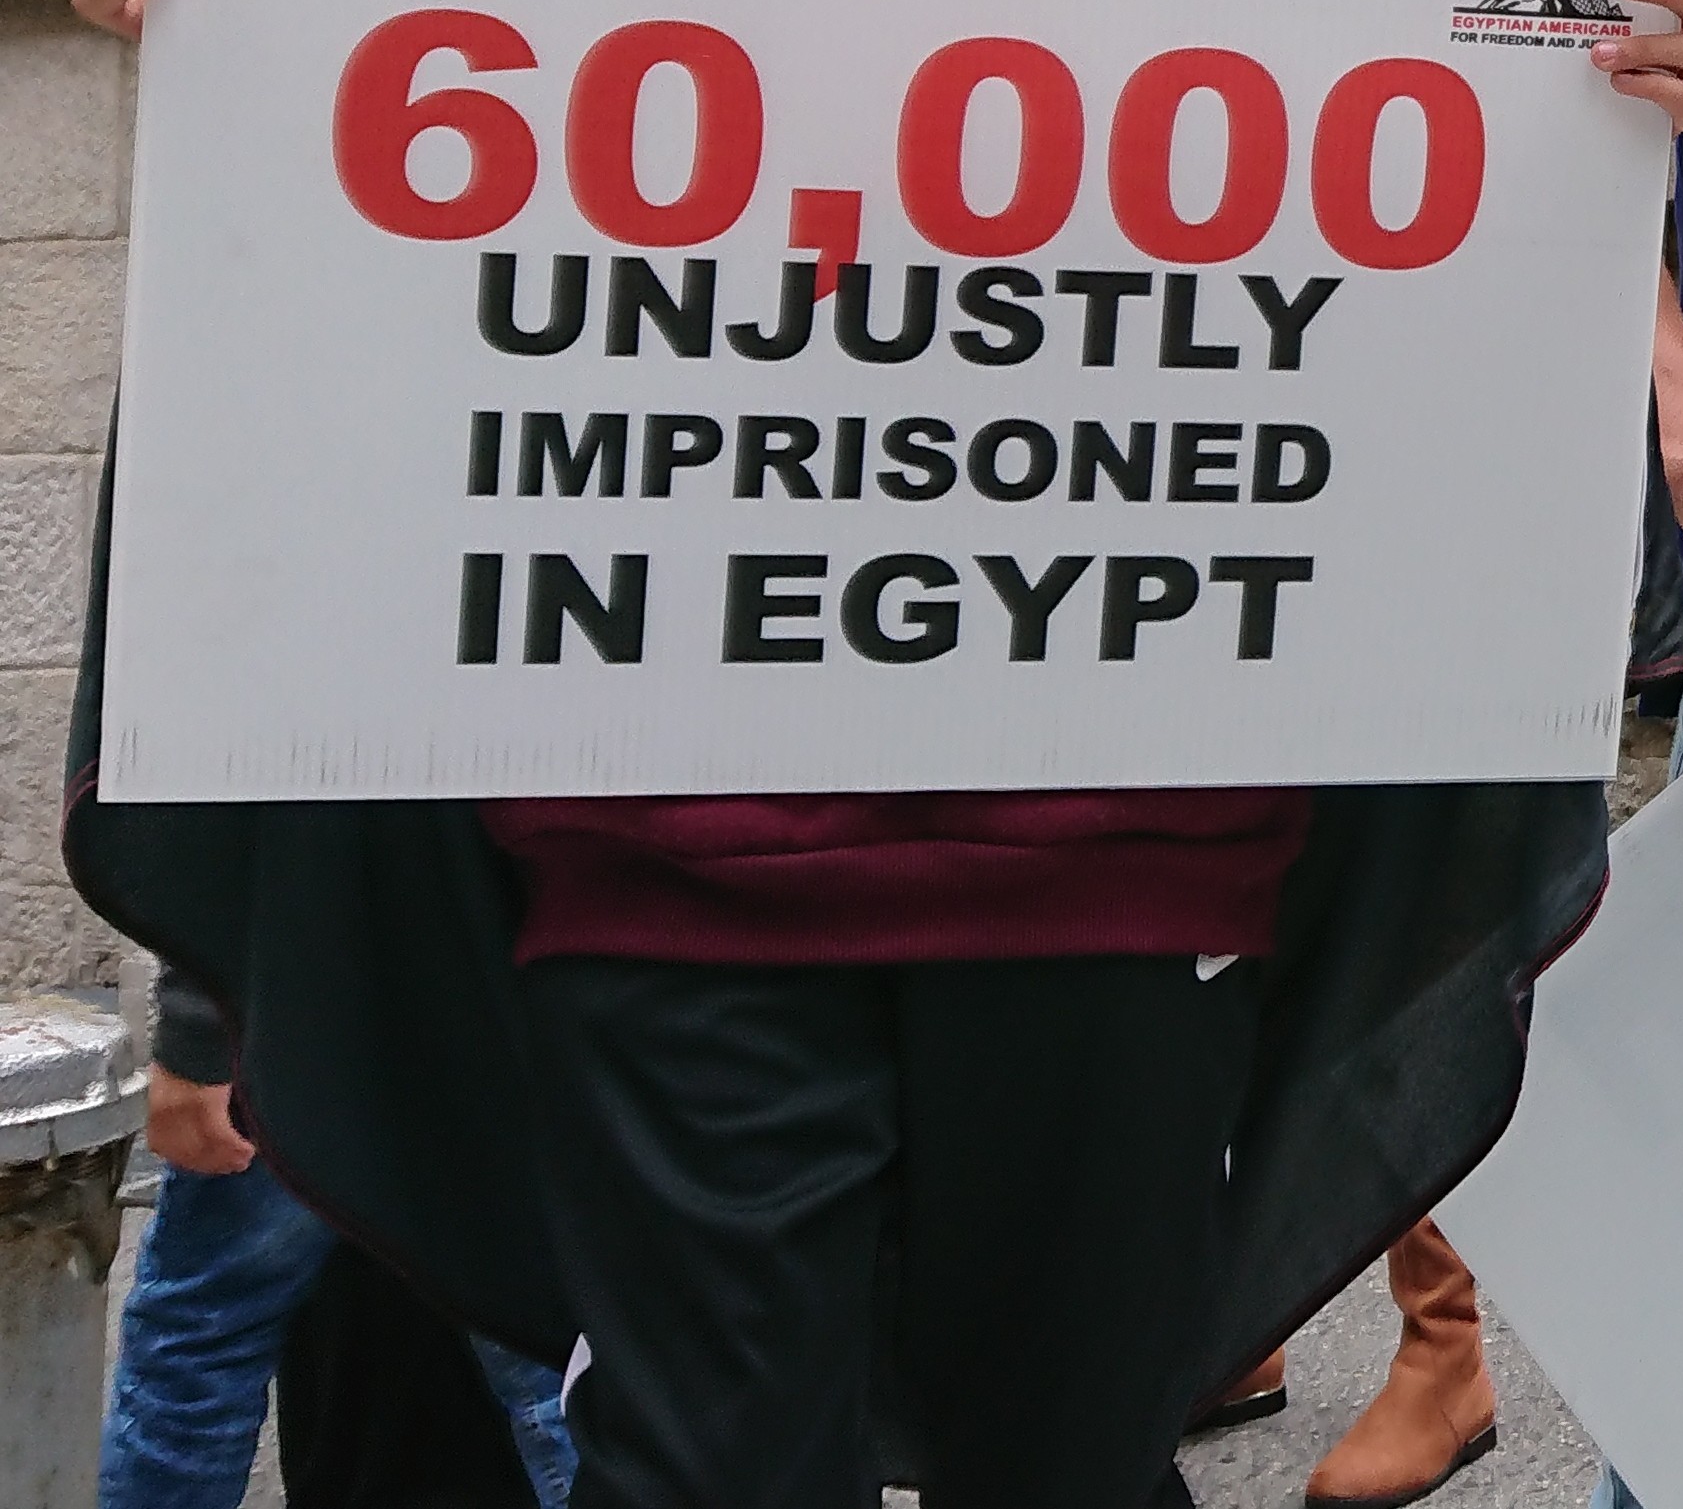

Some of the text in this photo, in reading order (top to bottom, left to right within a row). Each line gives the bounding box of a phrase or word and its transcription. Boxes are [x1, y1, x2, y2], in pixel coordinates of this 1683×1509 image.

[1450, 32, 1477, 43] FOR
[1481, 33, 1544, 47] FREEDOM
[1547, 36, 1575, 49] AND
[1453, 16, 1632, 37] EGYPTIAN AMERICANS
[334, 9, 1486, 303] 60,000
[478, 252, 1345, 371] UNJUSTLY
[467, 411, 1332, 503] IMPRISONED
[456, 553, 1314, 664] IN EGYPT
